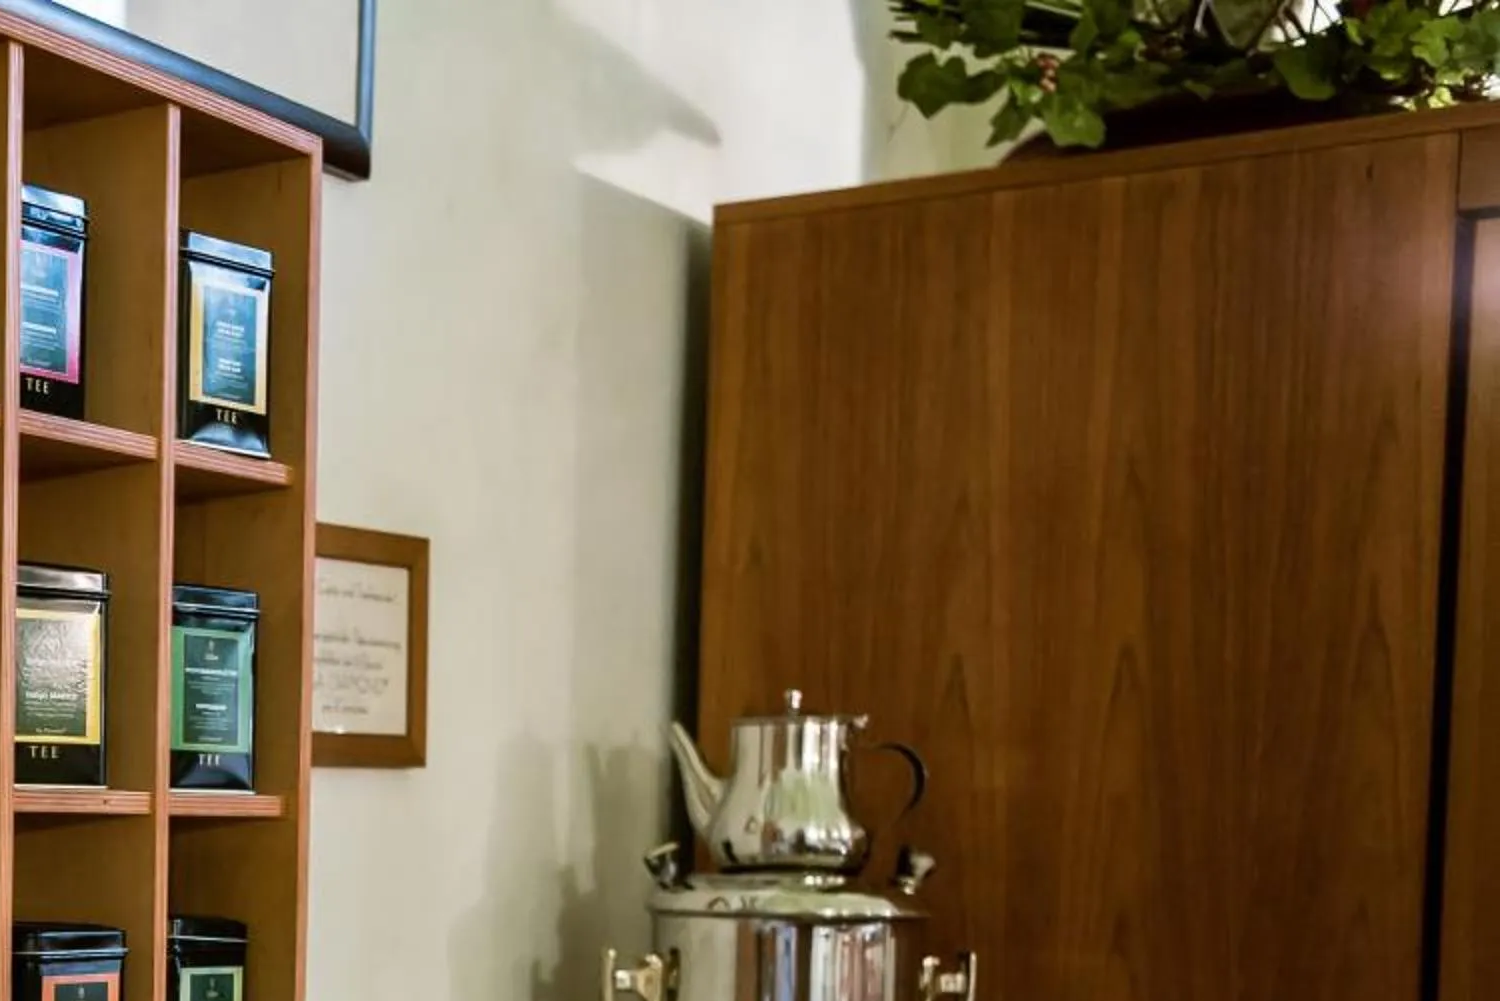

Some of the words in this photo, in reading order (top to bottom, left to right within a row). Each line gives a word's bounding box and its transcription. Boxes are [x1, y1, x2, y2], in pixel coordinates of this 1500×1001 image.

[25, 377, 50, 395] TEE
[216, 408, 238, 425] TEE
[28, 745, 61, 760] TEE
